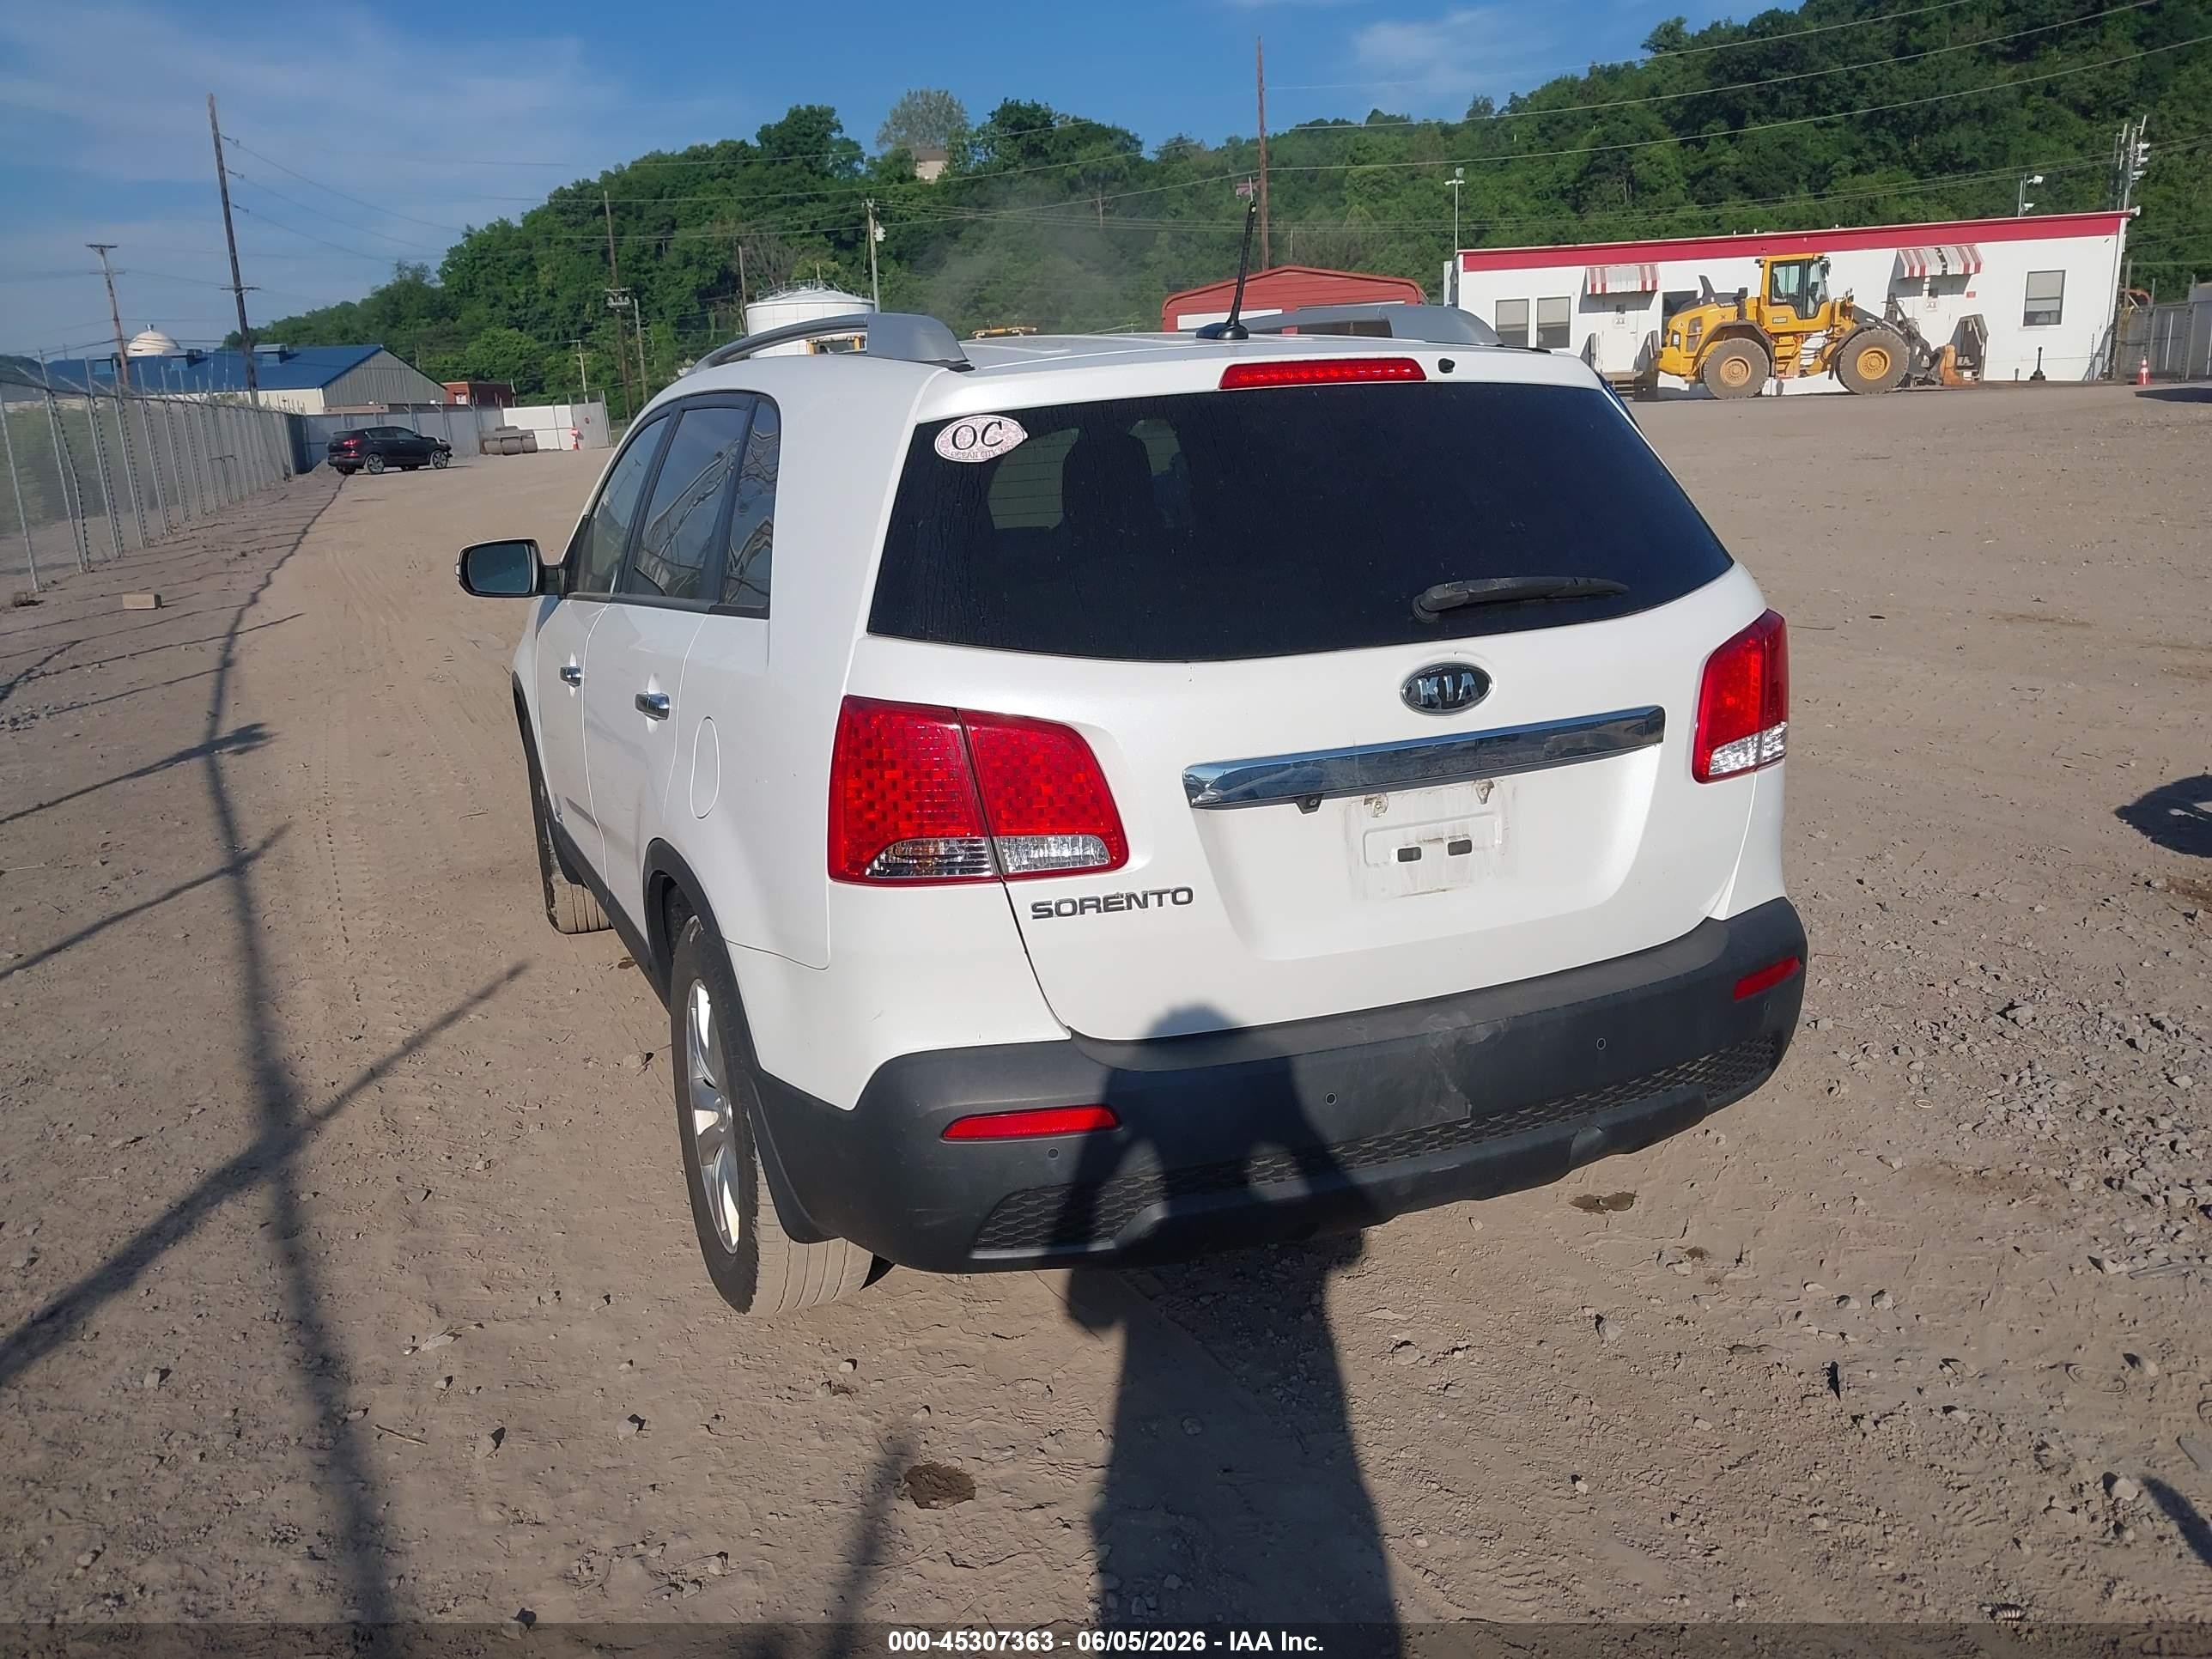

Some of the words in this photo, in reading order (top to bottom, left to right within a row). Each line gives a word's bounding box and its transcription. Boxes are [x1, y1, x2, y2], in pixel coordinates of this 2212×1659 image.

[951, 421, 1004, 450] OC
[951, 451, 978, 459] OCEAN
[1418, 672, 1479, 709] KIA
[1031, 887, 1194, 920] SORENTO
